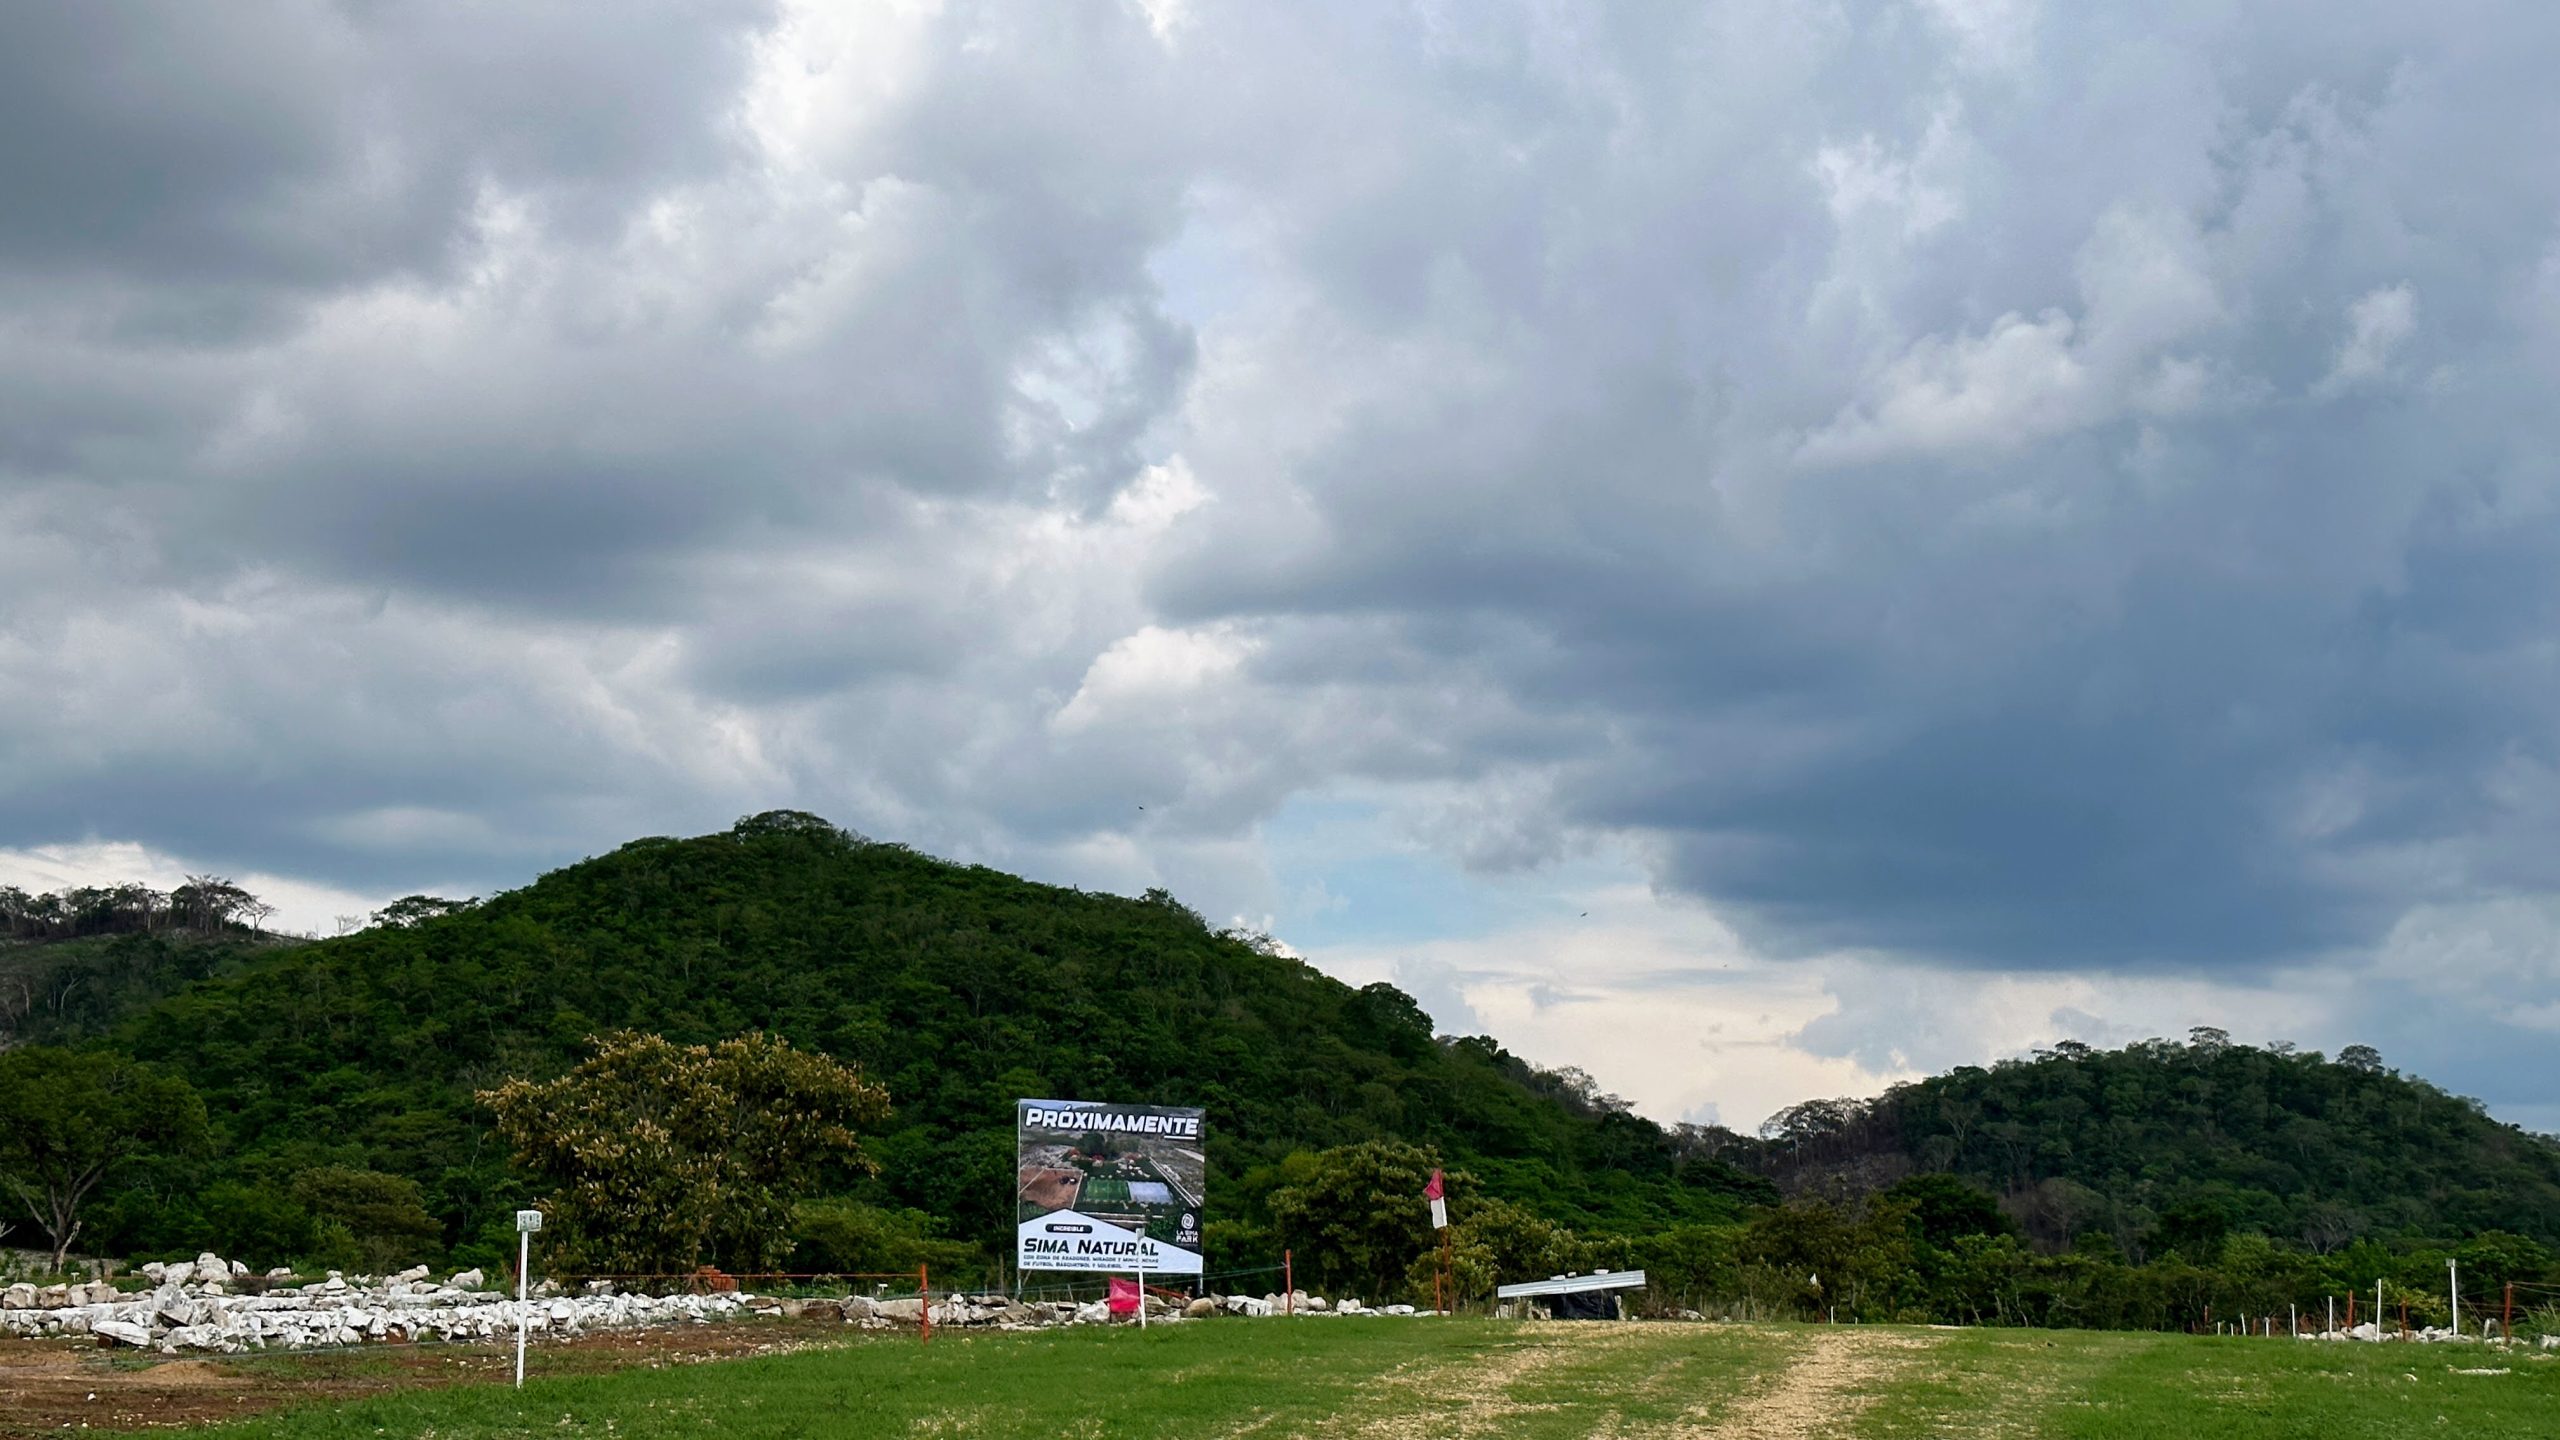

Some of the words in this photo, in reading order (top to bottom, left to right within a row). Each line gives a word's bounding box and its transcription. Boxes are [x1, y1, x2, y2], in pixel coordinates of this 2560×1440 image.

[1025, 1105, 1200, 1135] PRÓXIMAMENTE
[1024, 1238, 1069, 1253] SIMA
[1078, 1240, 1159, 1256] NATURAL
[1176, 1235, 1198, 1243] PARK
